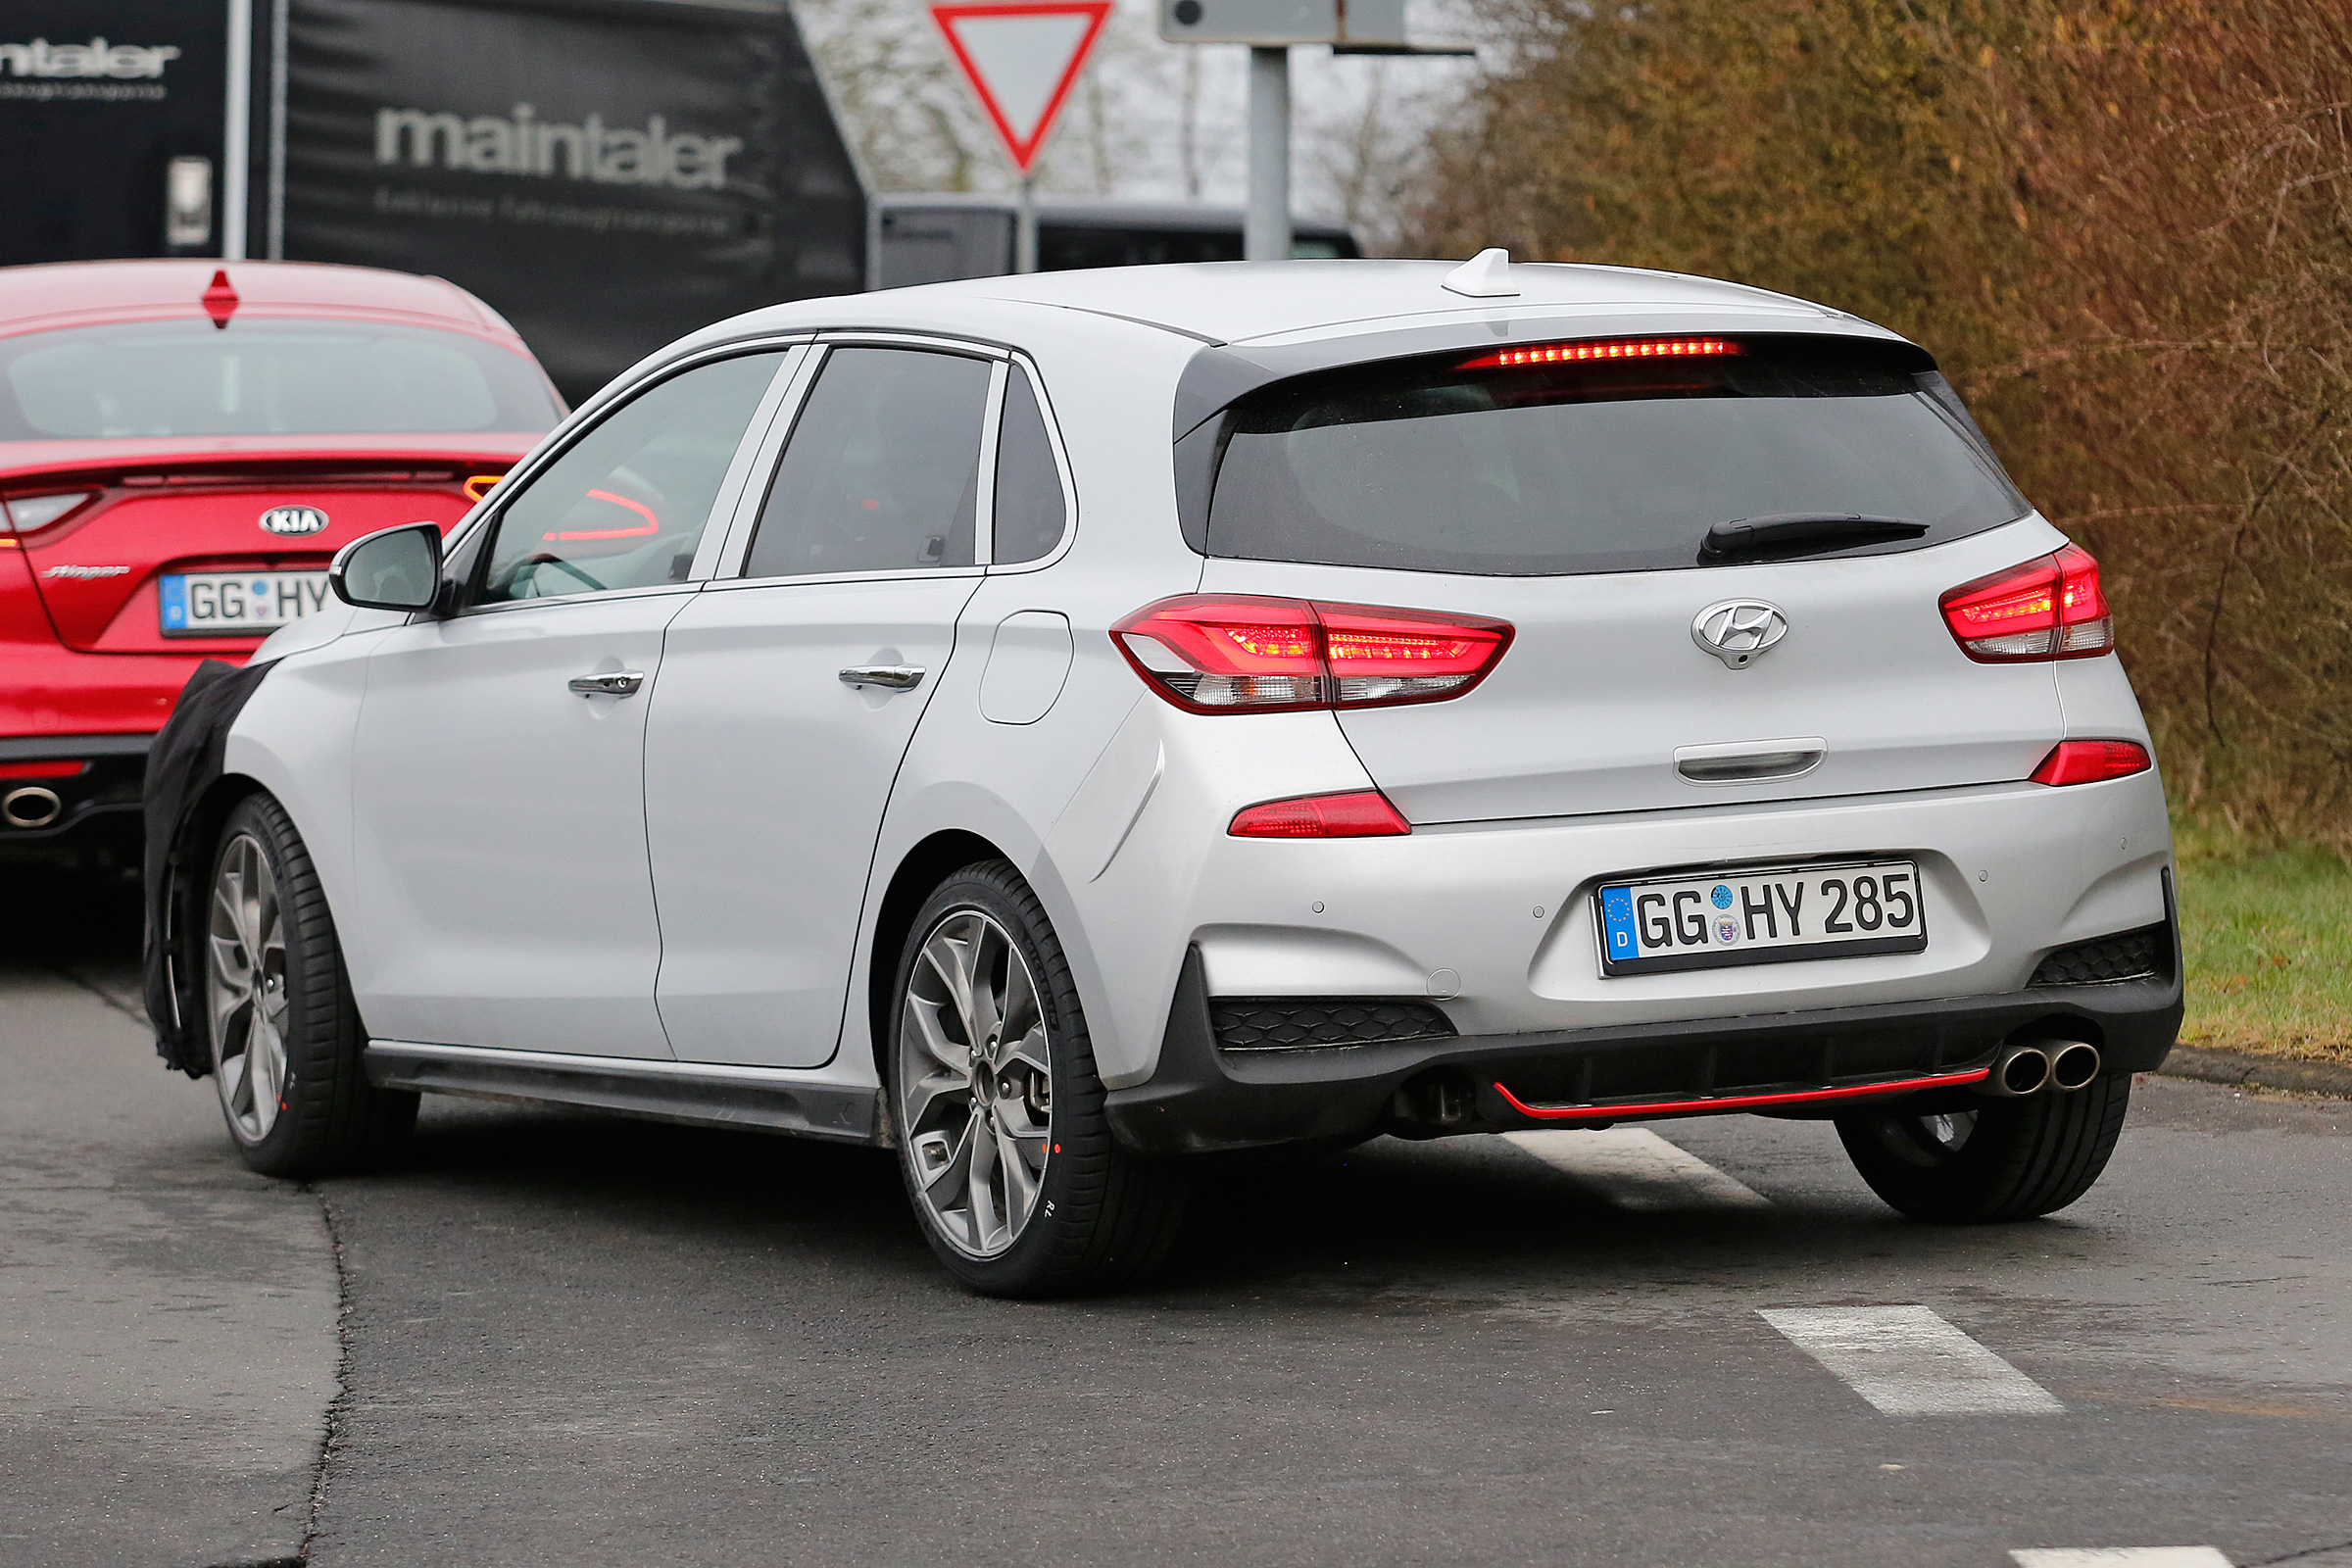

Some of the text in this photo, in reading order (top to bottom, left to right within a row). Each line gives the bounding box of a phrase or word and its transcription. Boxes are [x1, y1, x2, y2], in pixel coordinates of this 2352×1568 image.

[375, 102, 742, 188] maintaler
[270, 509, 321, 532] KIA
[191, 582, 244, 619] GG
[1637, 890, 1709, 950] GG
[1740, 881, 1804, 941] HY
[1820, 873, 1915, 934] 285
[1617, 930, 1629, 948] D
[1044, 1200, 1055, 1218] RL
